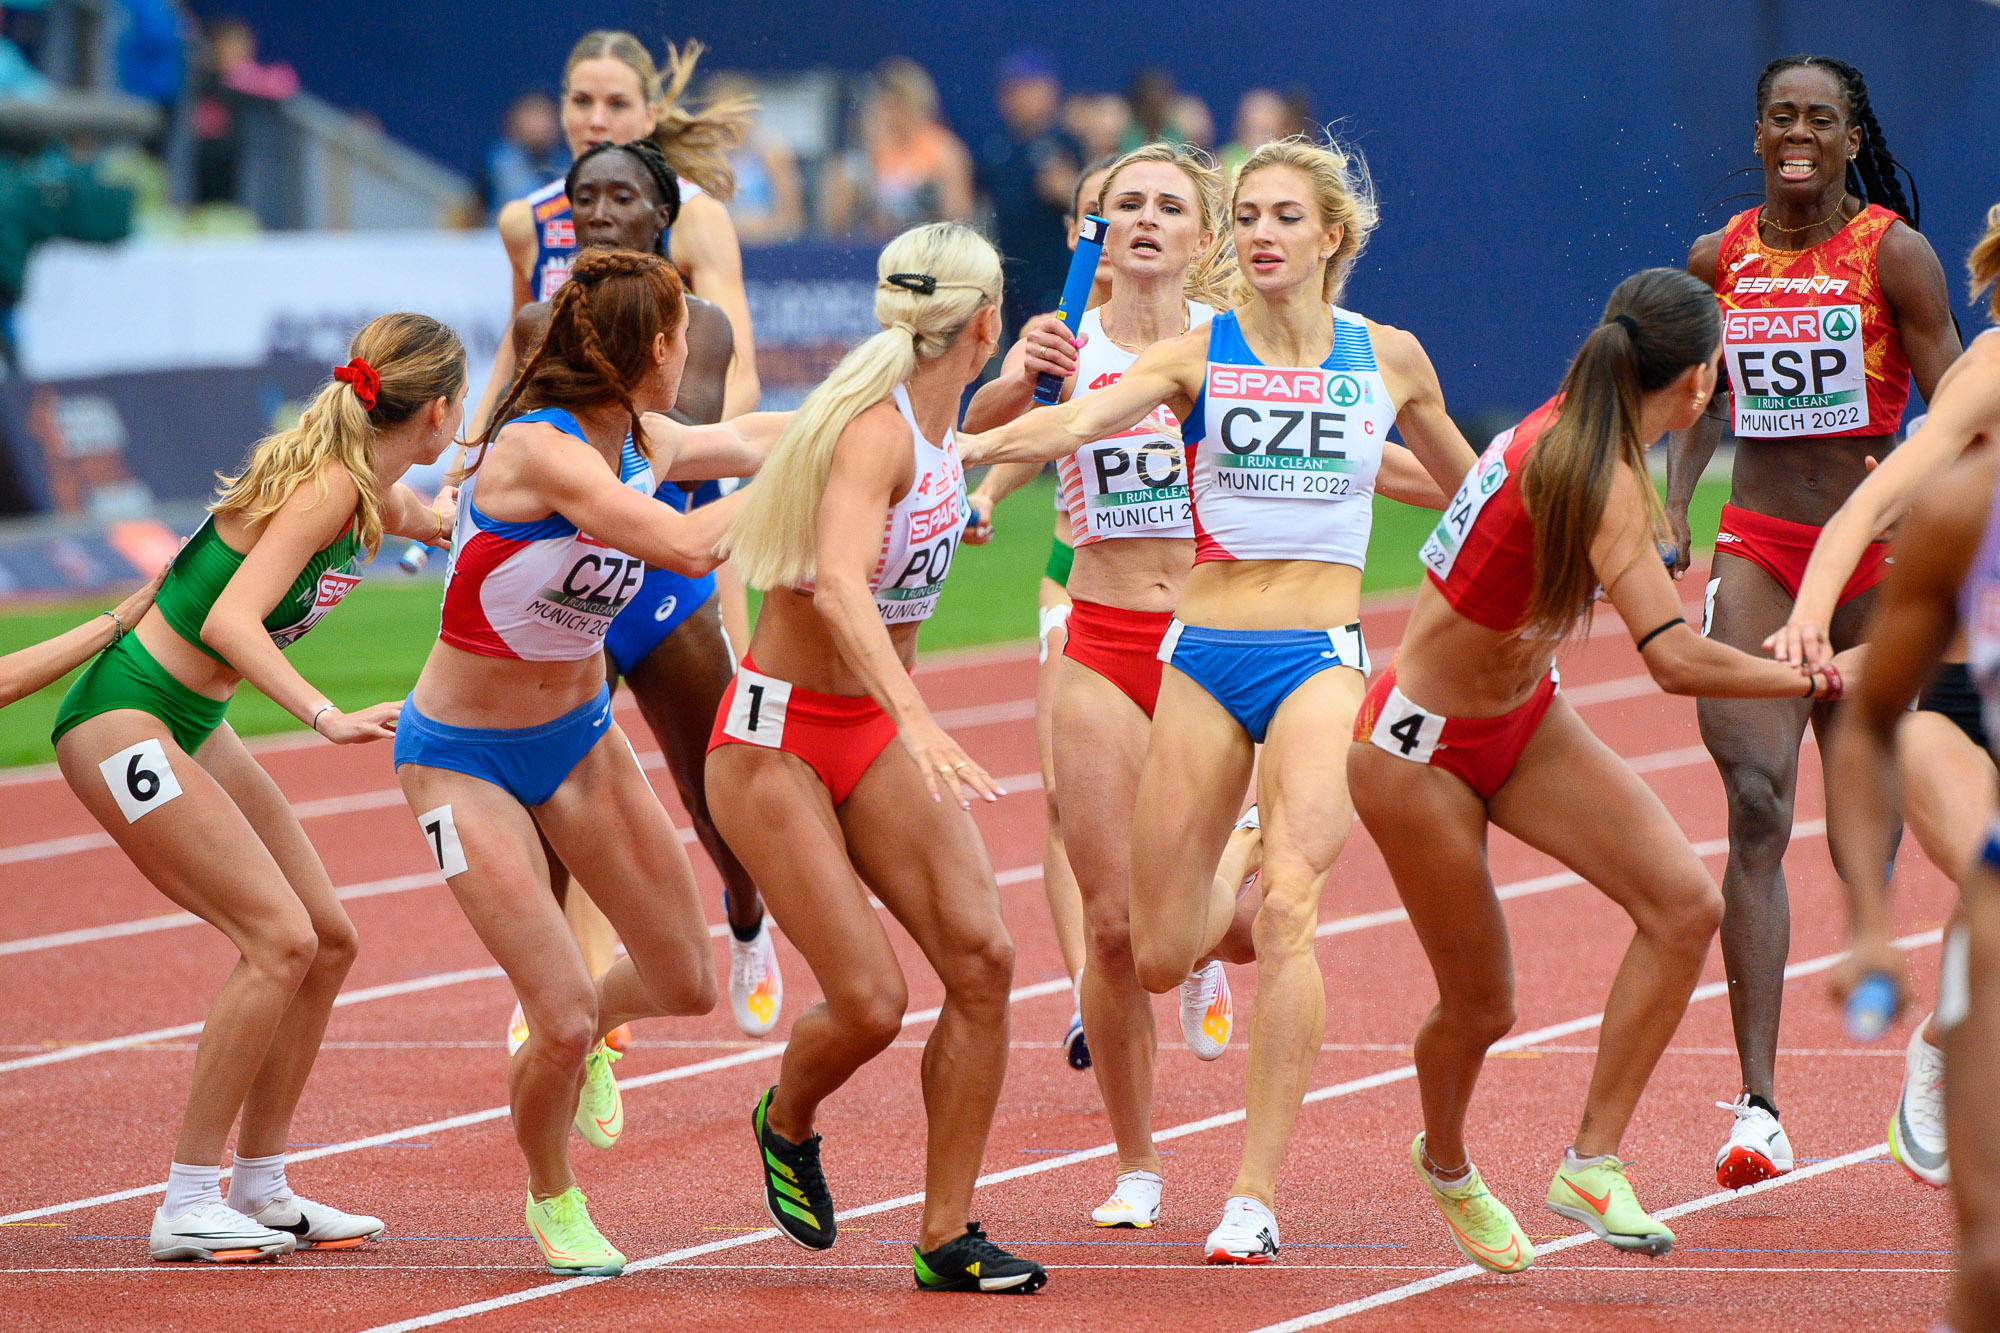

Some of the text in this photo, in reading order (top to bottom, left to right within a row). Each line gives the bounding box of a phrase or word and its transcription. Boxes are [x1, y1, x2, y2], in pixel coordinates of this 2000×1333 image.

[1733, 275, 1850, 296] ESPAÑA
[1728, 314, 1818, 340] SPAR
[1211, 371, 1321, 400] SPAR
[1737, 348, 1847, 397] ESP
[1762, 398, 1785, 409] RUN
[1220, 406, 1347, 460] CZE
[1741, 406, 1860, 432] MUNICH 2022
[1093, 441, 1181, 495] PO
[1247, 456, 1277, 468] RUN
[1126, 490, 1153, 503] RUN
[1156, 486, 1190, 499] CLEA
[1218, 471, 1350, 496] MUNICH 2022
[911, 496, 959, 541] SPAR
[1096, 505, 1174, 530] MUNICH
[318, 579, 355, 603] SPA
[562, 553, 642, 605] CZE
[567, 597, 590, 610] RUN
[526, 600, 610, 637] MUNICH 20
[747, 684, 765, 732] 1
[1390, 713, 1426, 756] 4
[126, 753, 161, 802] 6
[425, 819, 445, 870] 7
